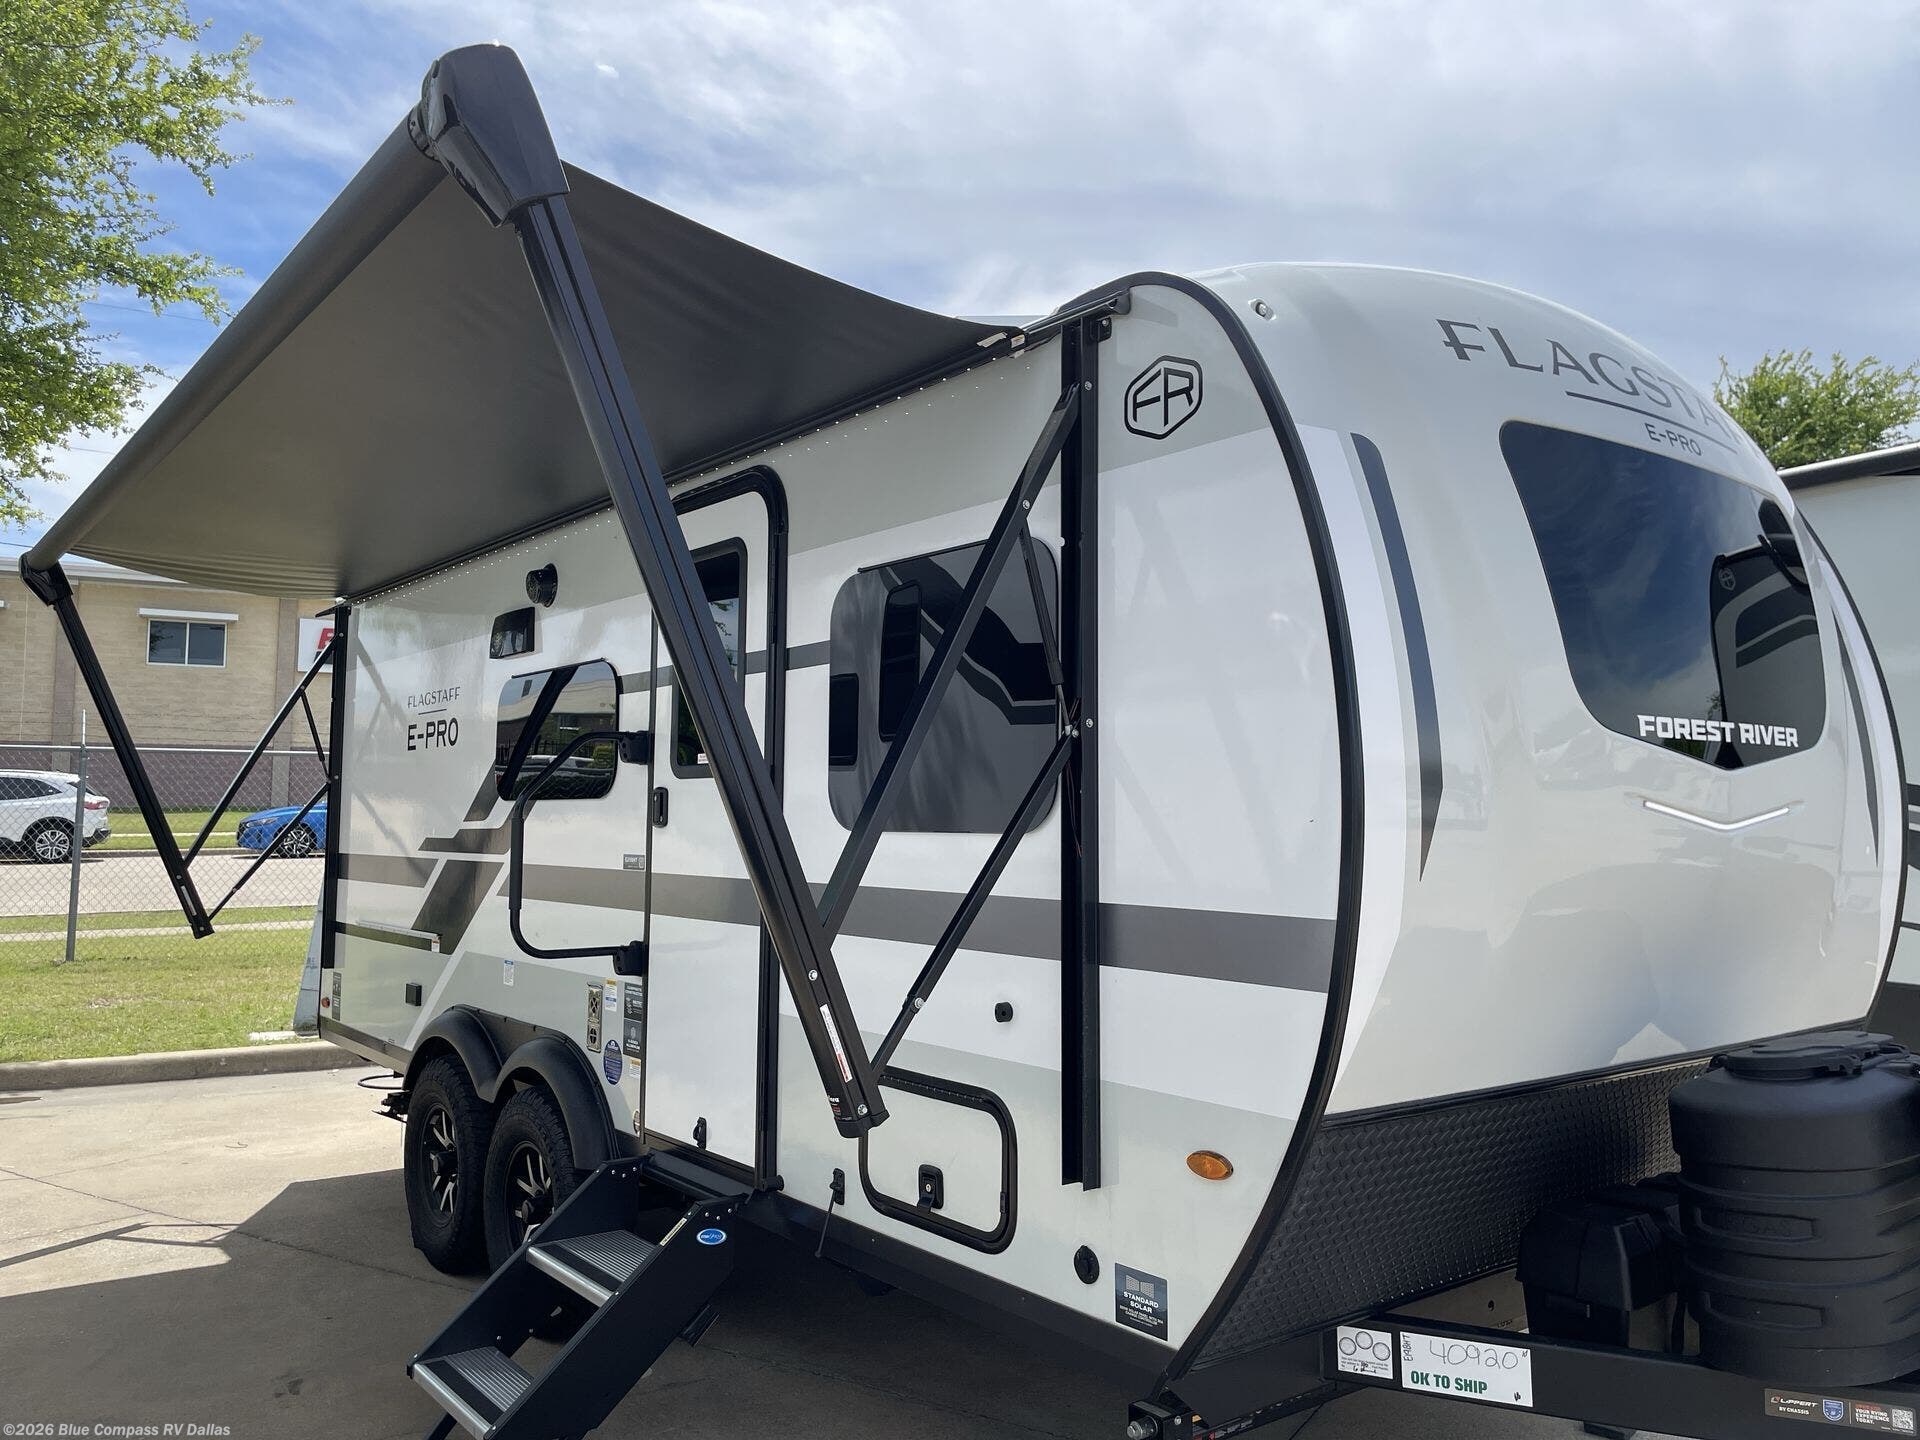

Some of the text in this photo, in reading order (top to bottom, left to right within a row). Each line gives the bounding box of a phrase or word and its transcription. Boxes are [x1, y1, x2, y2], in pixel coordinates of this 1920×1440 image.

[1436, 318, 1761, 456] FLAGSTA
[1644, 422, 1702, 456] E-PRO
[408, 687, 461, 709] FLAGSTAFF
[407, 717, 459, 751] E-PRO
[1637, 714, 1799, 748] FOREST RIVER
[1123, 1291, 1159, 1309] STANDARD
[1130, 1300, 1153, 1314] SOLAR
[1430, 1340, 1519, 1369] 40920
[1410, 1370, 1488, 1394] OK TO SHIP
